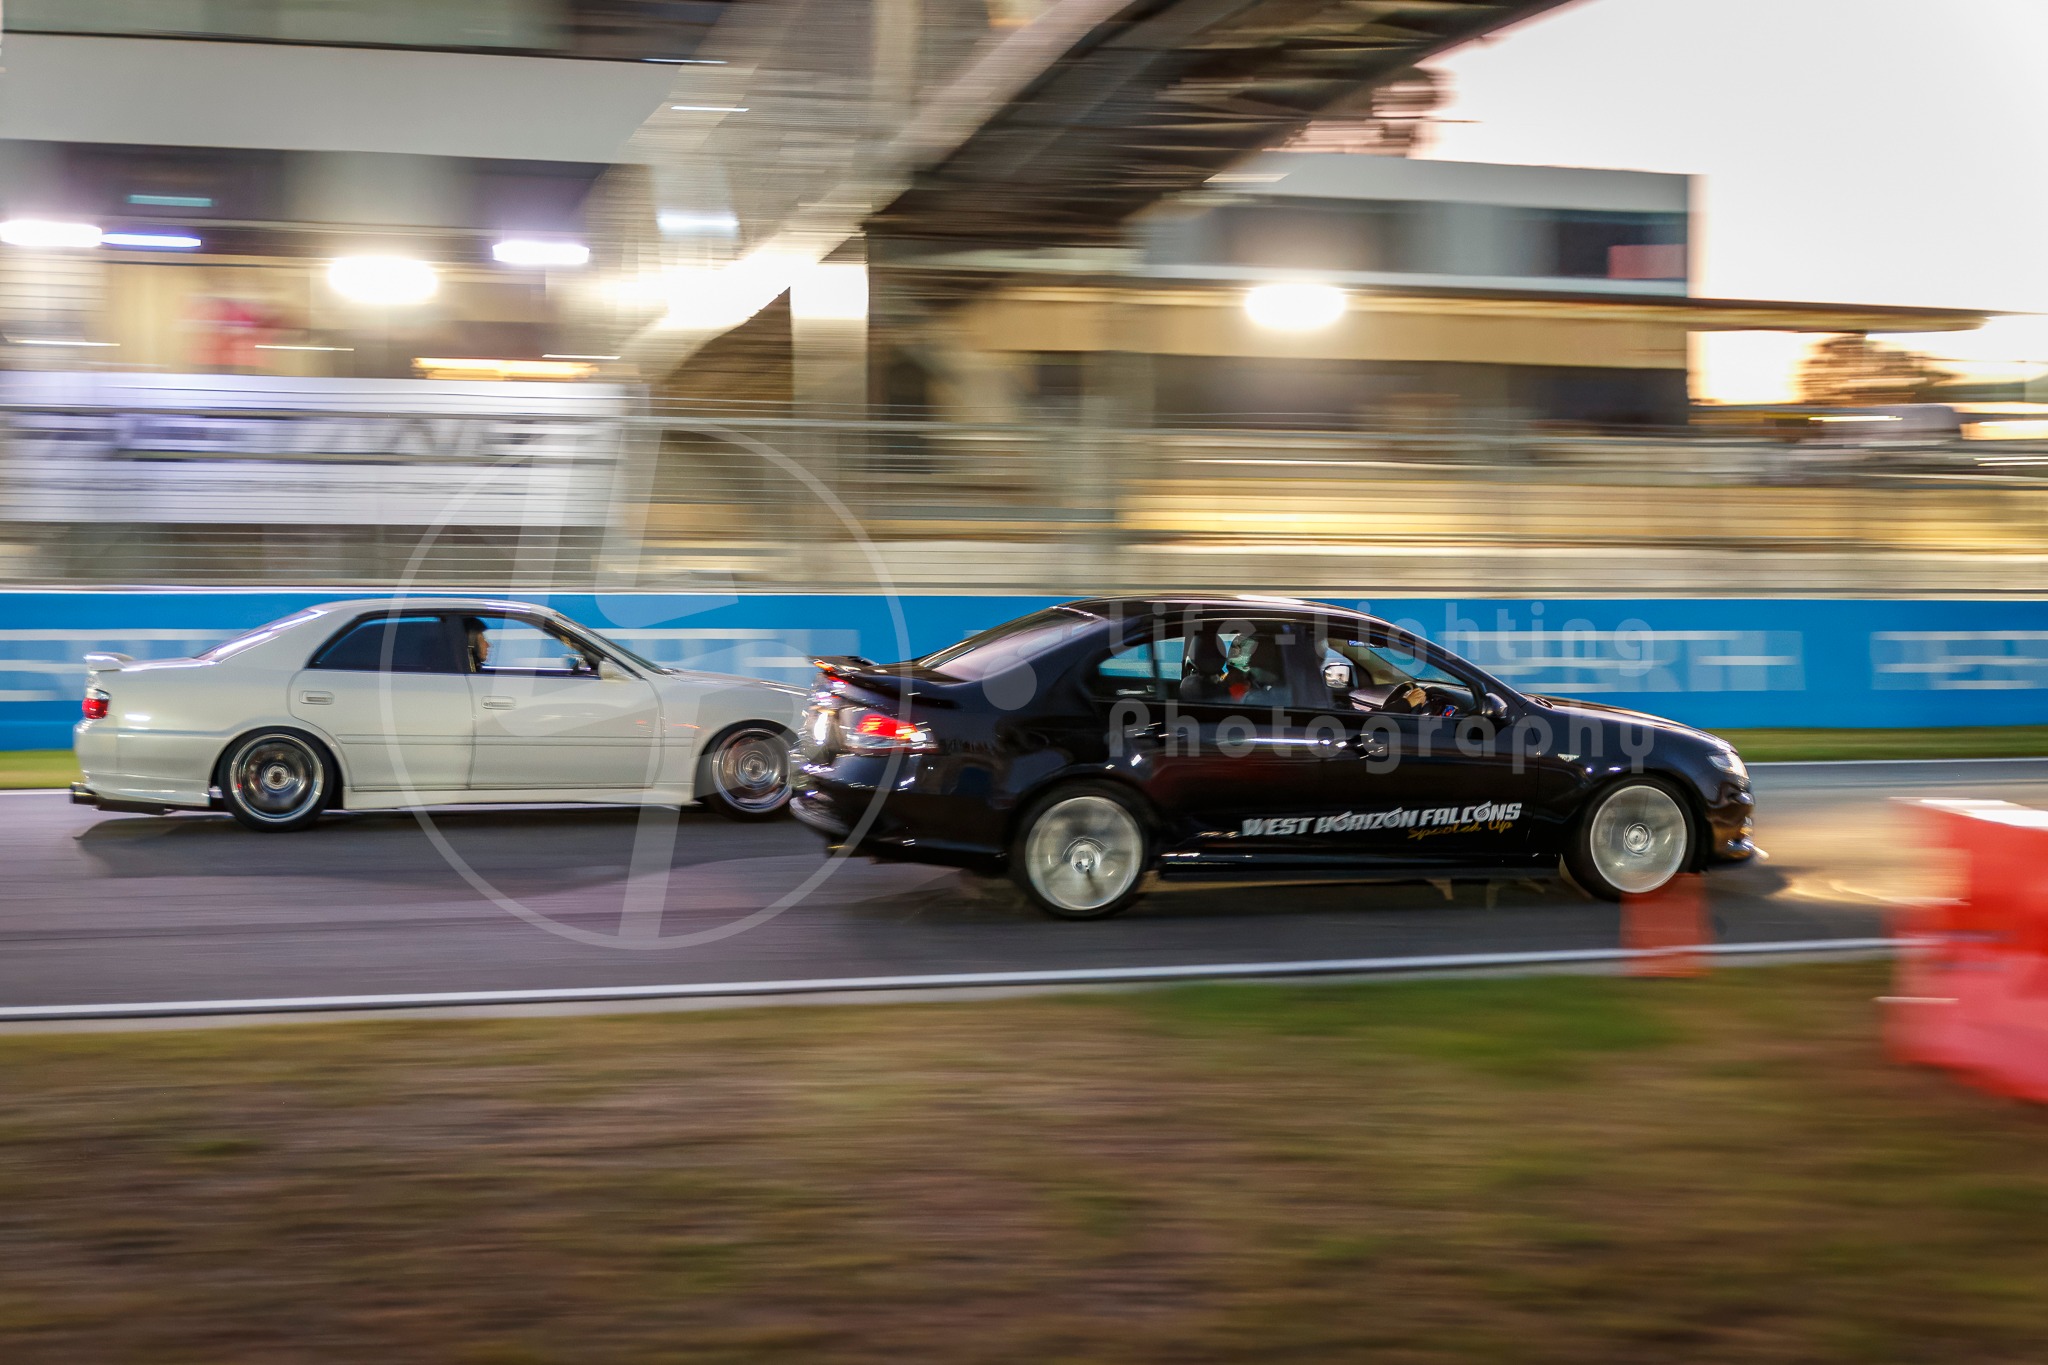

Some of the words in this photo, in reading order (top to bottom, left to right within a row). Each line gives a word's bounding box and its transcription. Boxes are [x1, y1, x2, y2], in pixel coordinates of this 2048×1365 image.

[1241, 816, 1315, 837] WEST
[1312, 806, 1419, 834] HORIZON
[1418, 800, 1522, 827] FALCONS
[1487, 819, 1513, 834] Up
